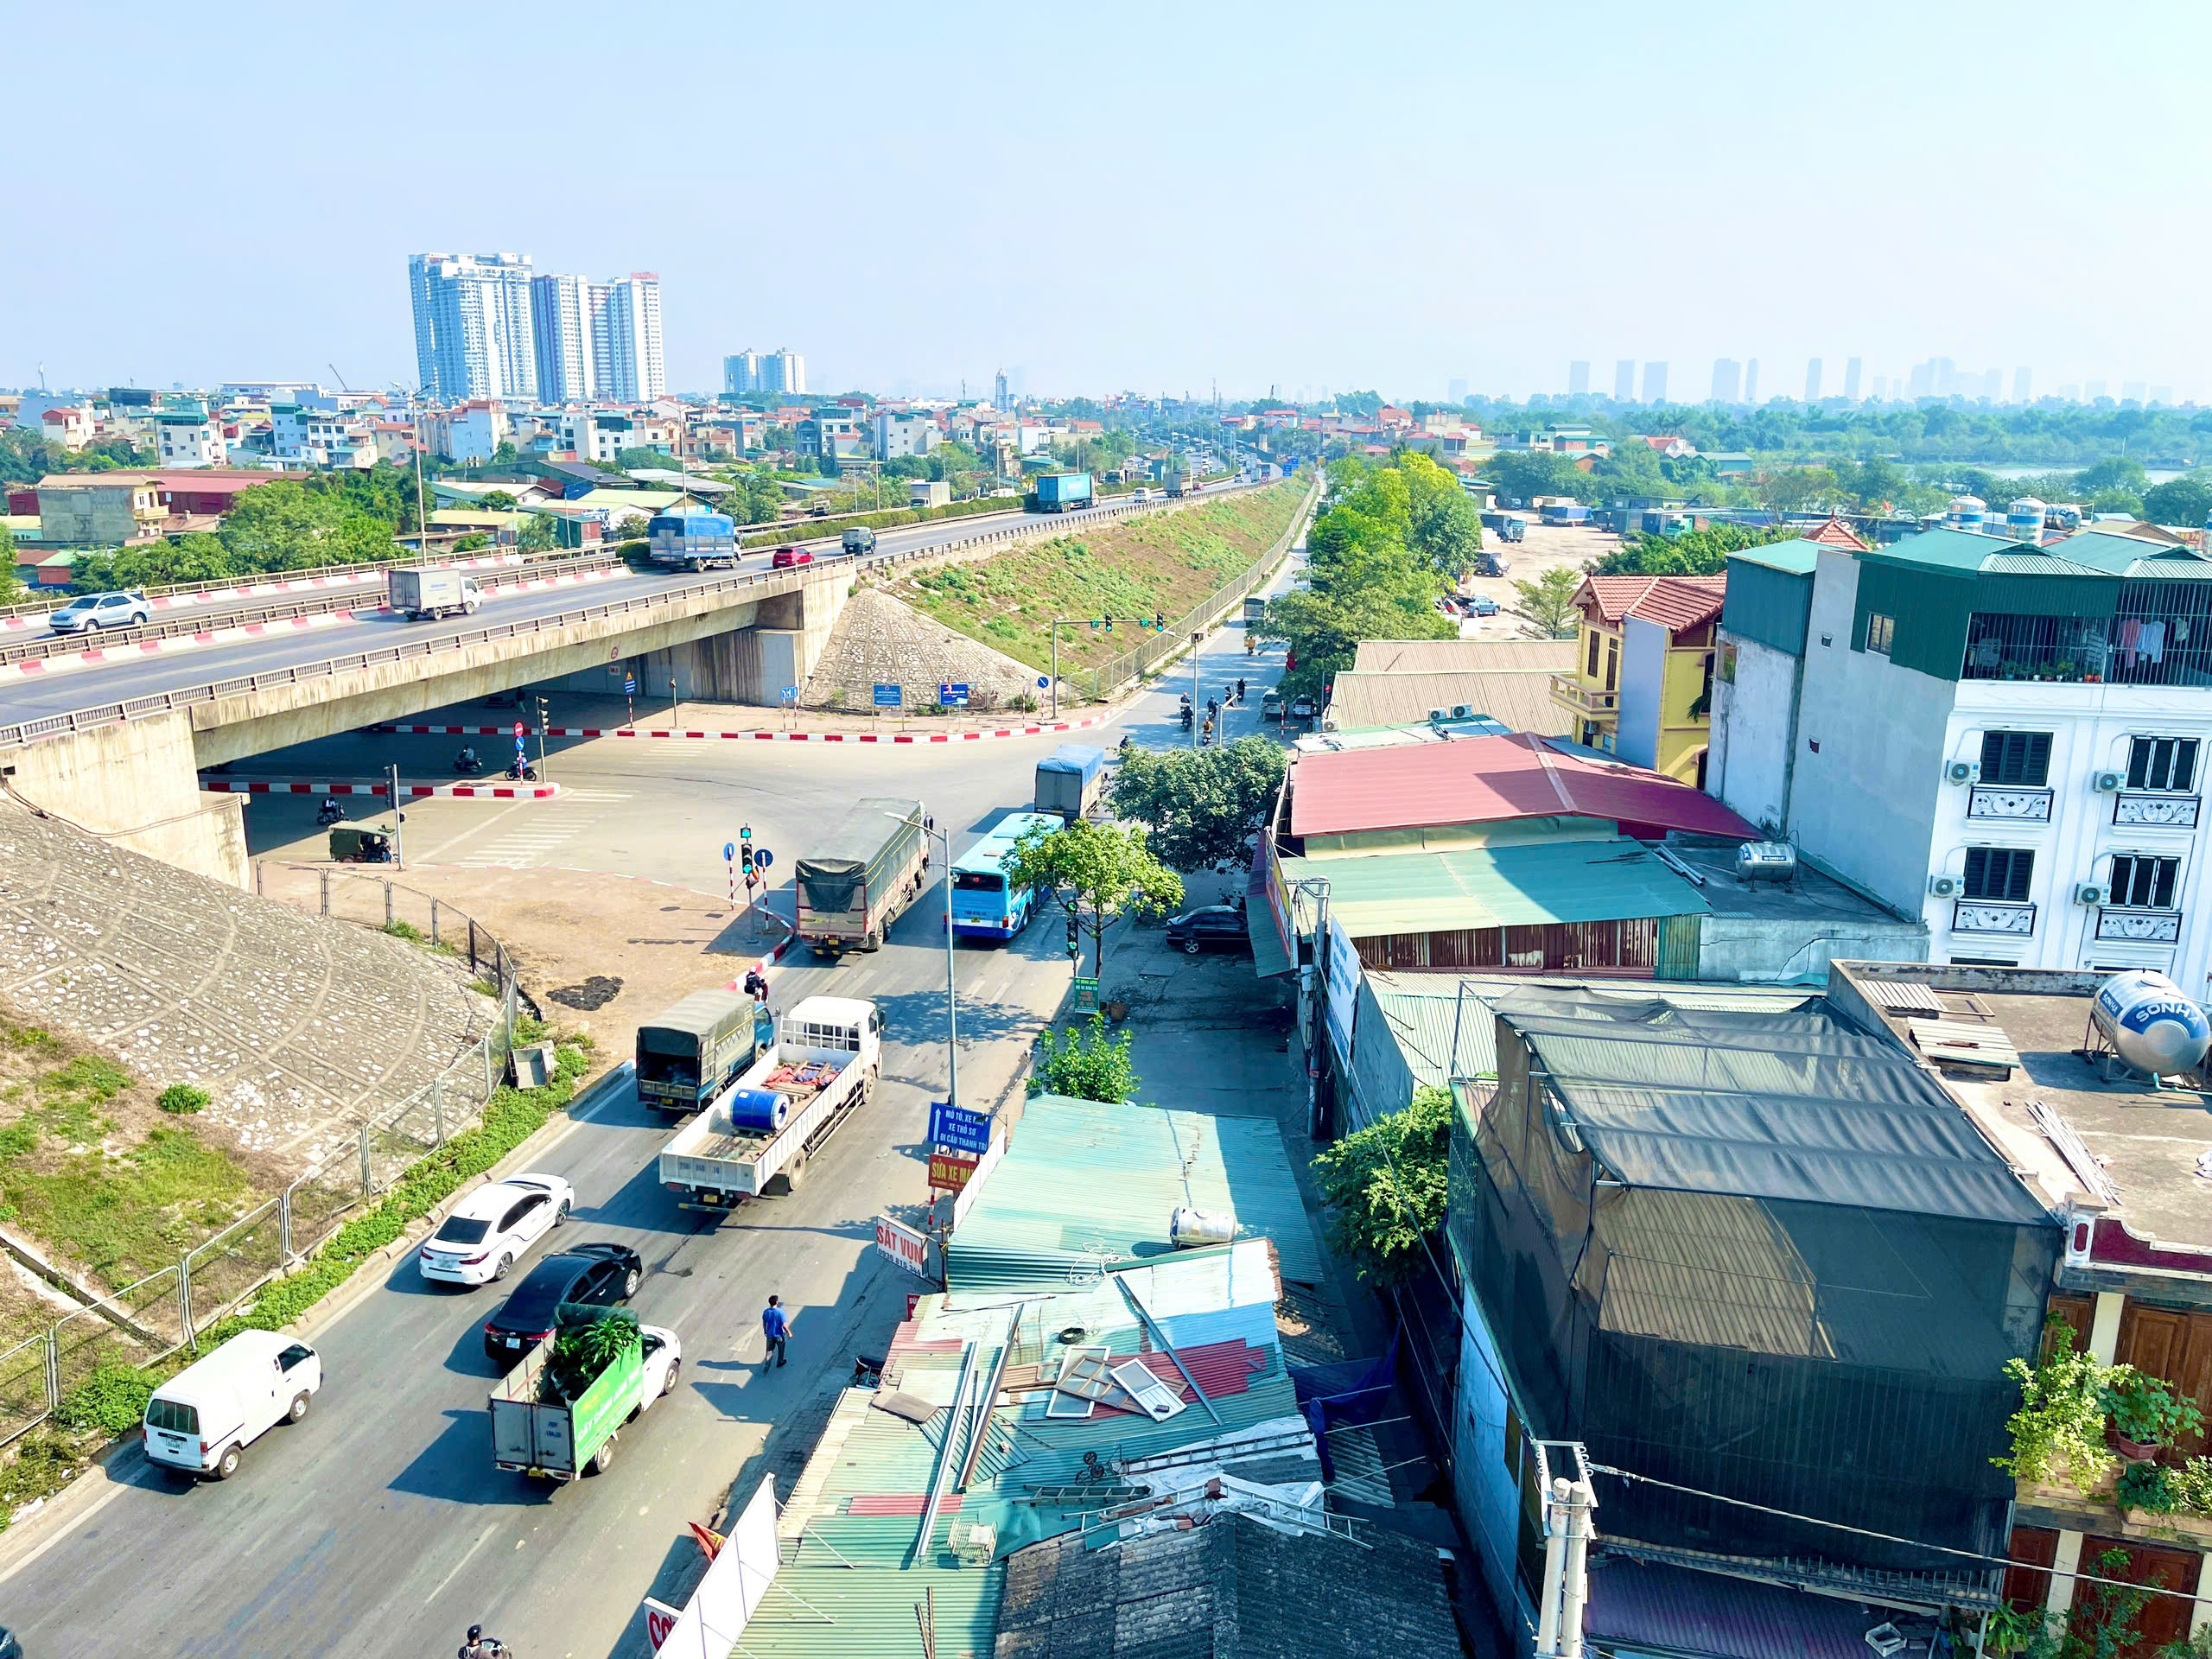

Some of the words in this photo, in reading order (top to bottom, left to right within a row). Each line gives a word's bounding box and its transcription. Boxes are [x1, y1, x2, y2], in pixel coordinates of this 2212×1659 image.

[2135, 1001, 2200, 1028] SONHA
[948, 1122, 956, 1132] XE
[964, 1114, 972, 1123] XE
[959, 1137, 977, 1148] THANH
[931, 1158, 946, 1179] SỬA
[948, 1165, 958, 1181] XE
[959, 1165, 974, 1183] MÁ
[877, 1222, 897, 1251] SẮT
[899, 1236, 923, 1266] VỤN
[649, 1611, 676, 1651] CƠ
